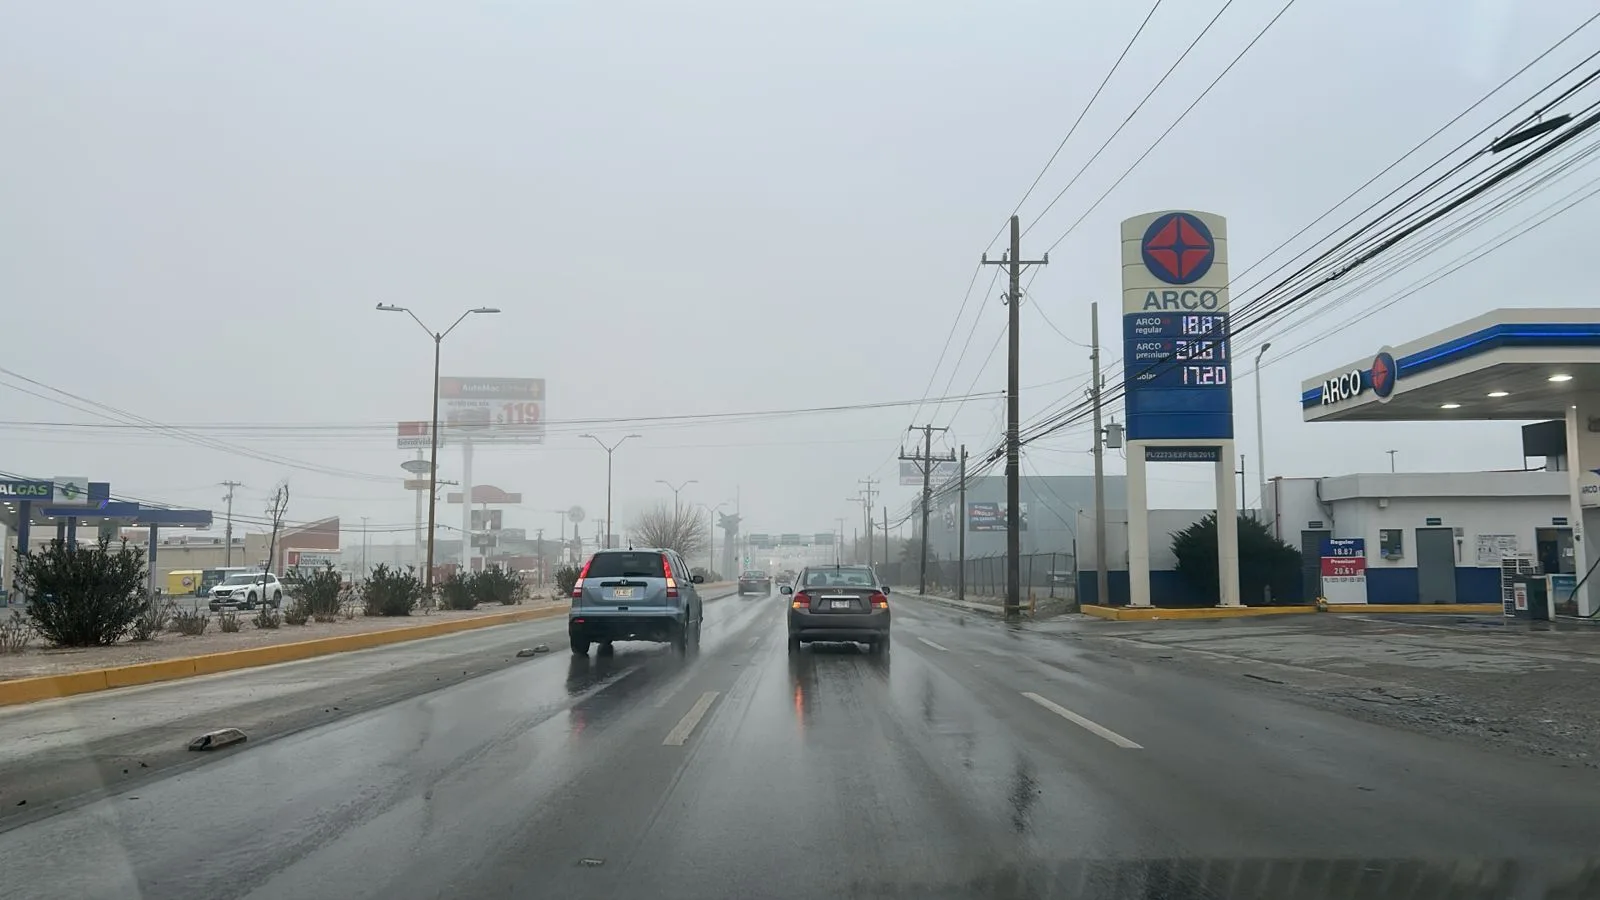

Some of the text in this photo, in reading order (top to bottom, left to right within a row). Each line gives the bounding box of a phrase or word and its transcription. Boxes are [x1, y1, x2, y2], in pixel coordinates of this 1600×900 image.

[1143, 290, 1218, 311] ARCO
[1135, 315, 1226, 335] ARCO 18.87
[1135, 326, 1163, 336] regular
[1136, 342, 1162, 351] ARCO
[1136, 351, 1171, 361] premium
[1182, 366, 1227, 386] 17.20
[1321, 368, 1362, 405] ARCO
[503, 402, 541, 425] 119
[1333, 548, 1353, 556] 18.87
[1333, 567, 1355, 576] 20.61
